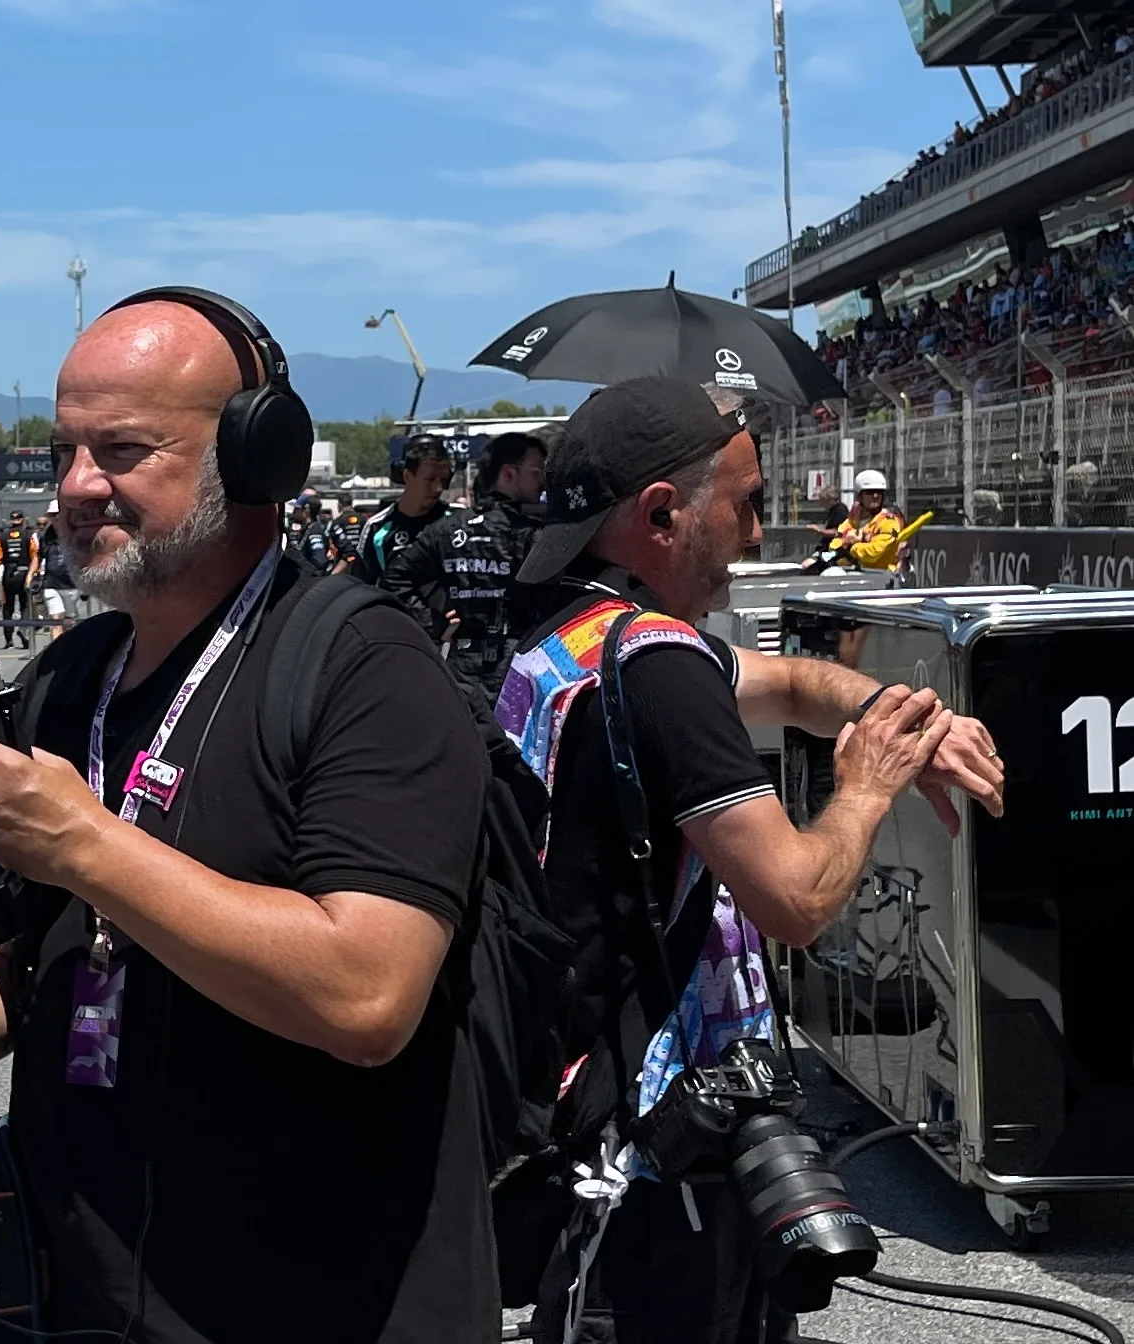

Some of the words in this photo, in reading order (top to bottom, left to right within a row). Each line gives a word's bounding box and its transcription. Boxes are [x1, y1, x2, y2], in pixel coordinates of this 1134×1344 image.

[20, 460, 53, 473] MSC
[988, 552, 1030, 586] MSC
[1082, 554, 1134, 589] MSC
[164, 681, 197, 730] MEDIA
[1070, 809, 1101, 821] KIMI
